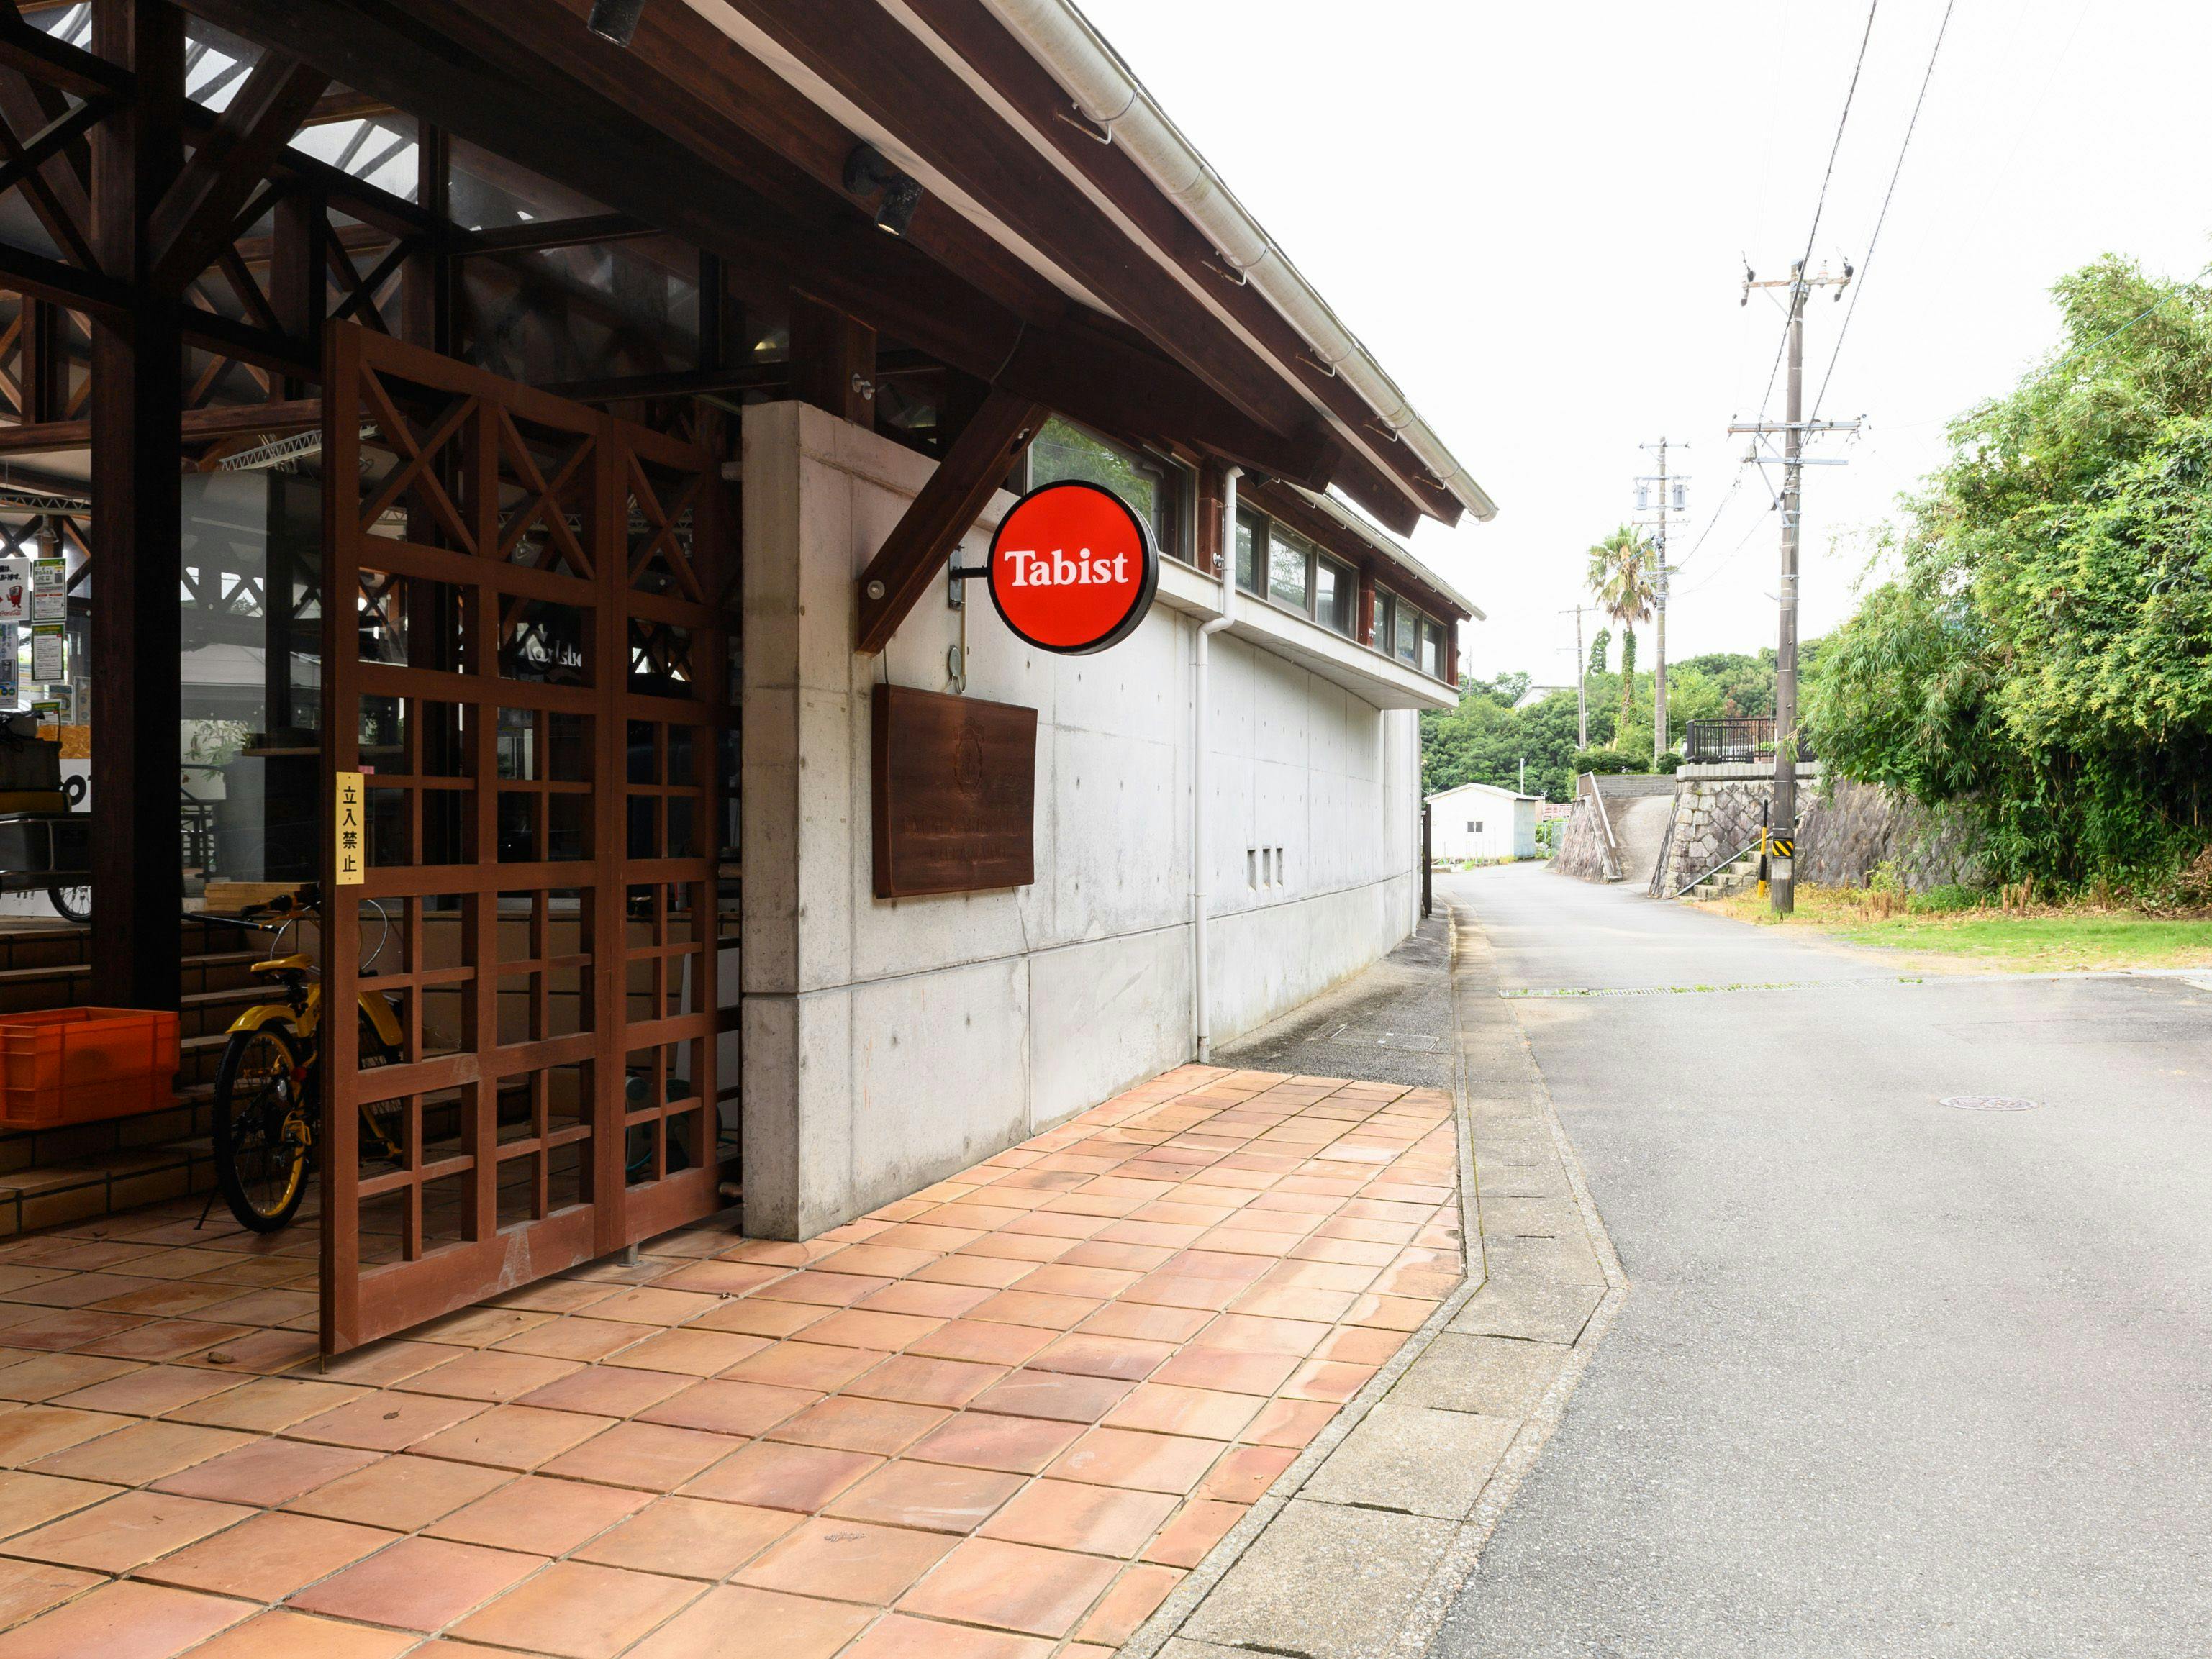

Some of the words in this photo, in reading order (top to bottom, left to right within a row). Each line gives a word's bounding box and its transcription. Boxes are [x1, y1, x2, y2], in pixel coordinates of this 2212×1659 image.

[1004, 547, 1129, 586] Tabist
[343, 786, 357, 872] 立入禁止
